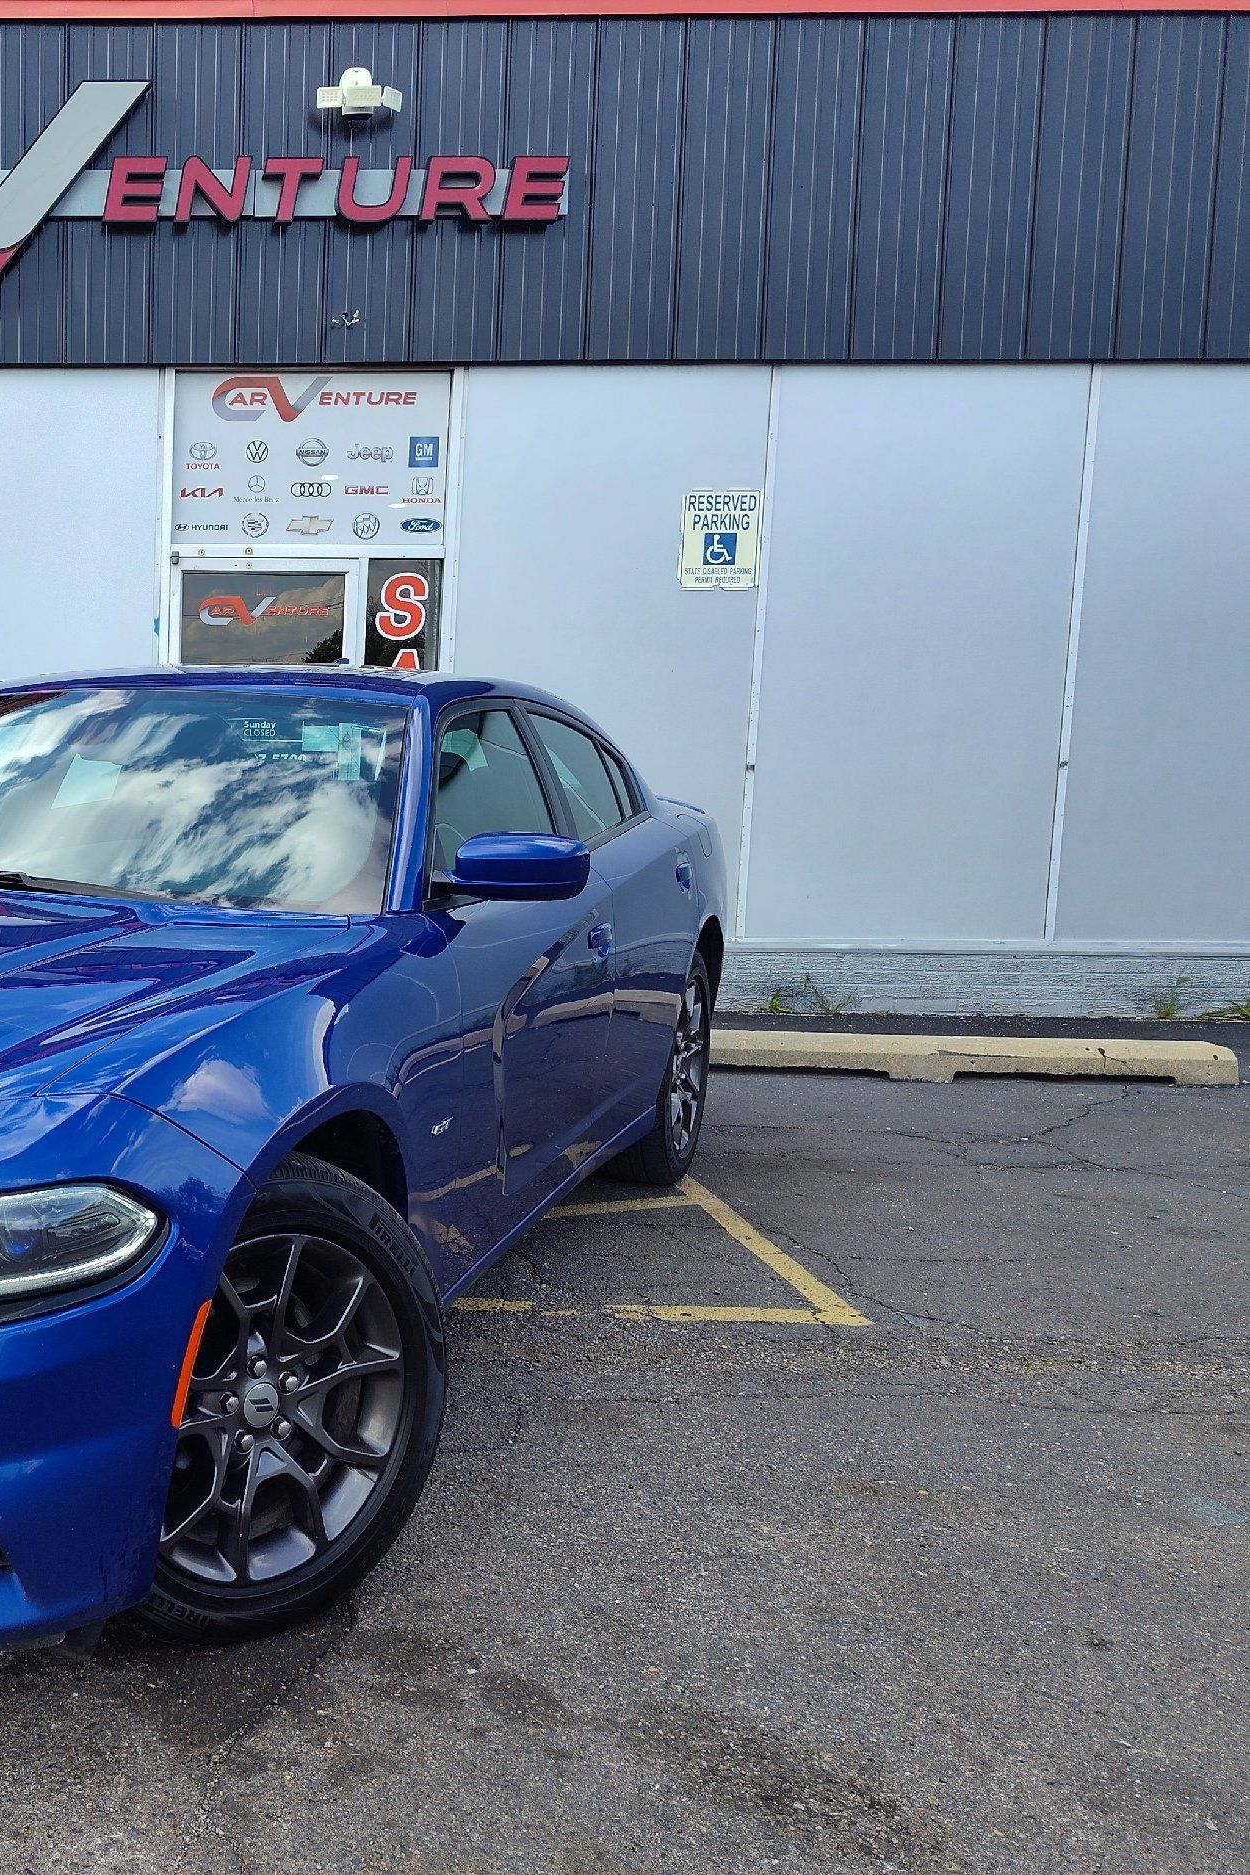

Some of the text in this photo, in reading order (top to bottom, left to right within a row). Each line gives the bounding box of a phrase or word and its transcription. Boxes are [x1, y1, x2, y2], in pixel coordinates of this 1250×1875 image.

[347, 443, 393, 462] Jeep
[415, 443, 433, 457] GM
[180, 487, 223, 497] KIA
[344, 485, 389, 495] GMC
[688, 494, 757, 511] RESERVED
[408, 520, 433, 531] Ford
[693, 514, 750, 530] PARKING
[685, 567, 752, 575] STATE DISABLED PARKING
[244, 721, 276, 729] Sunday
[244, 728, 276, 737] CLOSED
[367, 1212, 418, 1277] PIRELLI
